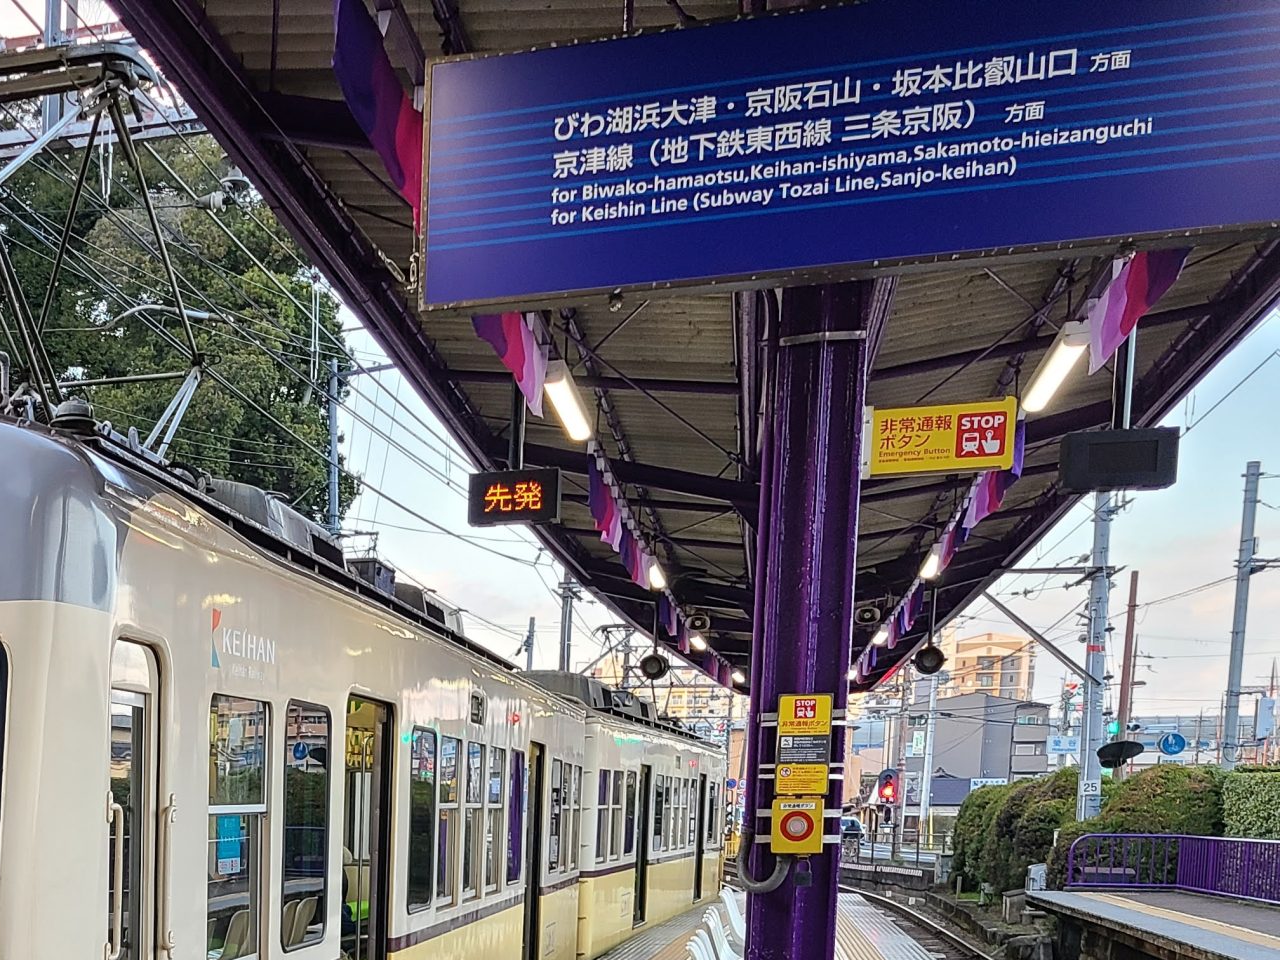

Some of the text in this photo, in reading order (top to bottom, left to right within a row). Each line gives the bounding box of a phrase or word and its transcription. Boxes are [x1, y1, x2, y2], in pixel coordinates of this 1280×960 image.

[553, 48, 1132, 141] びわ湖浜大津・京阪石山・坂本比叡山口 方面
[841, 99, 975, 142] 三条京阪）
[1004, 100, 1046, 124] 方面
[551, 156, 1018, 226] for Keishin Line (Subway Tozai Line,Sanjo-keihan)
[551, 187, 577, 204] for
[880, 414, 953, 434] 非常通報
[960, 415, 1005, 430] STOP
[880, 434, 931, 450] ボタン
[879, 450, 920, 458] Emergency
[484, 481, 542, 513] 先発
[223, 627, 275, 665] KEIHAN
[1083, 782, 1097, 793] 25
